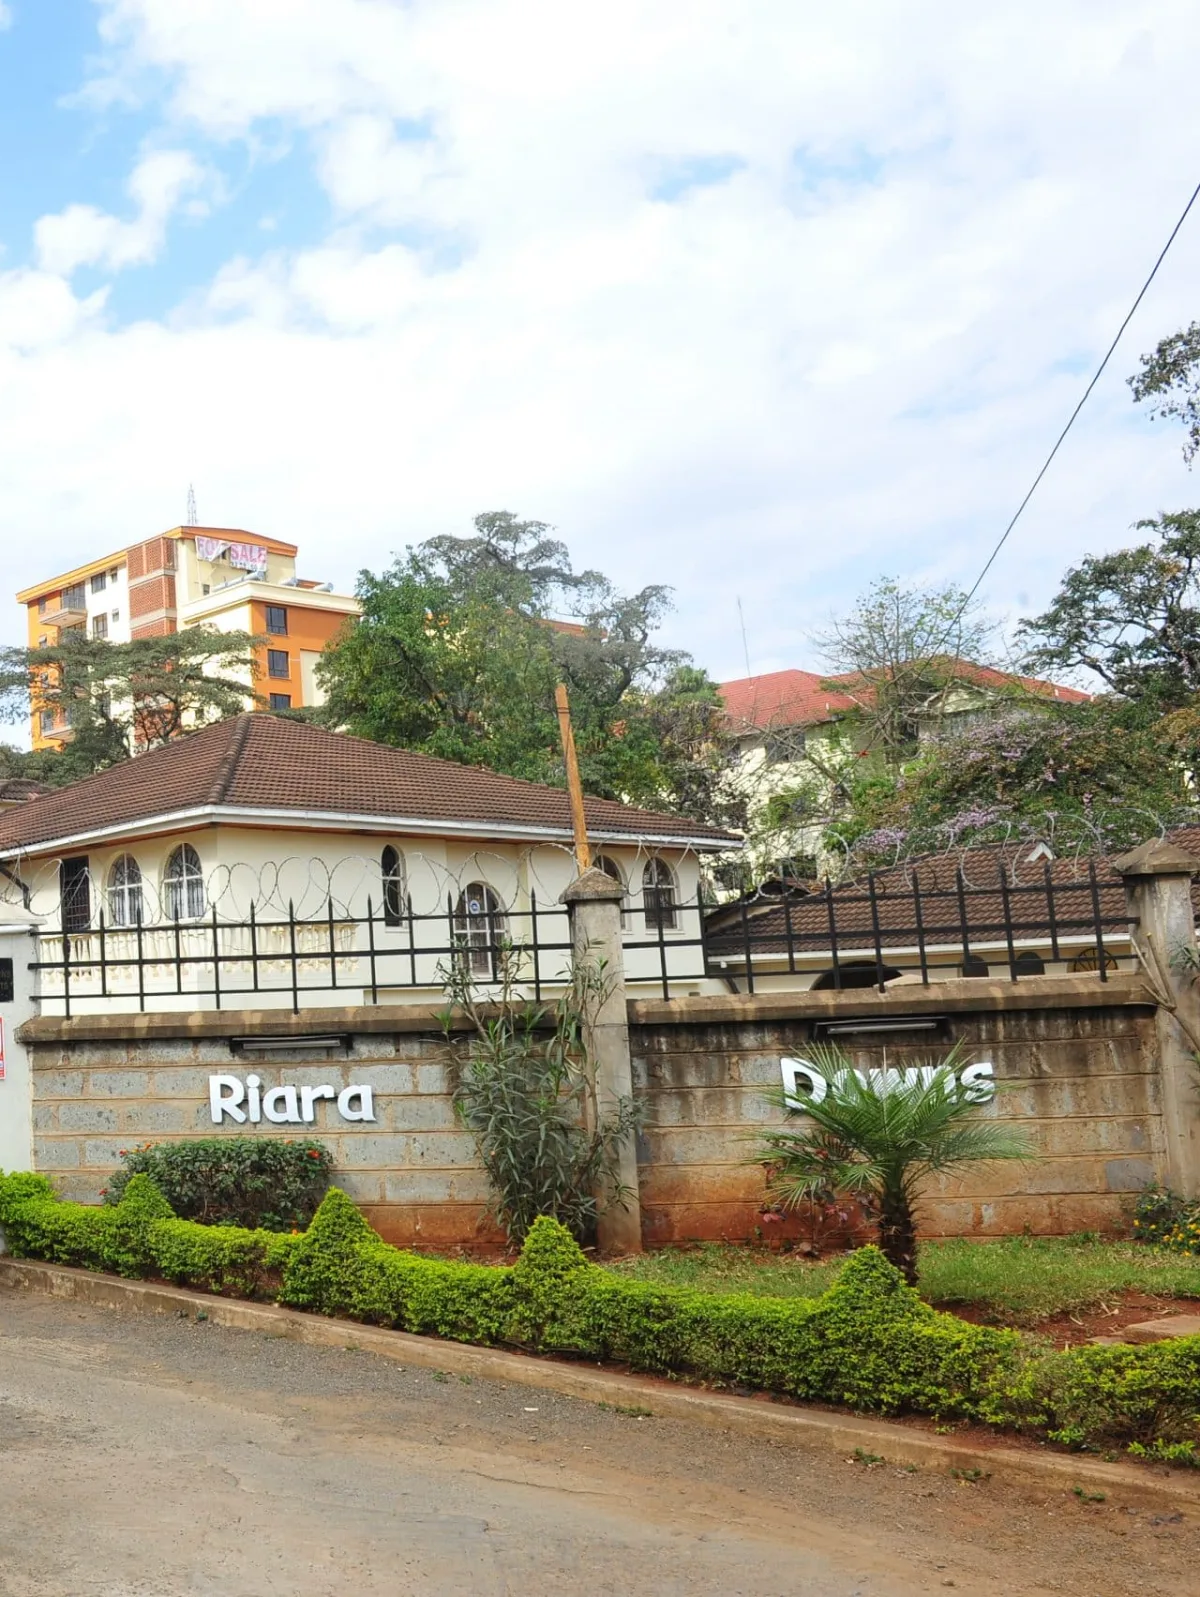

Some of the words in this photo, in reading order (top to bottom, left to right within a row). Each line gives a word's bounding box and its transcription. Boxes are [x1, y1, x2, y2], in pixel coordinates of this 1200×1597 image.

[197, 538, 219, 559] FO
[231, 544, 266, 564] SALE
[209, 1074, 377, 1123] Riara
